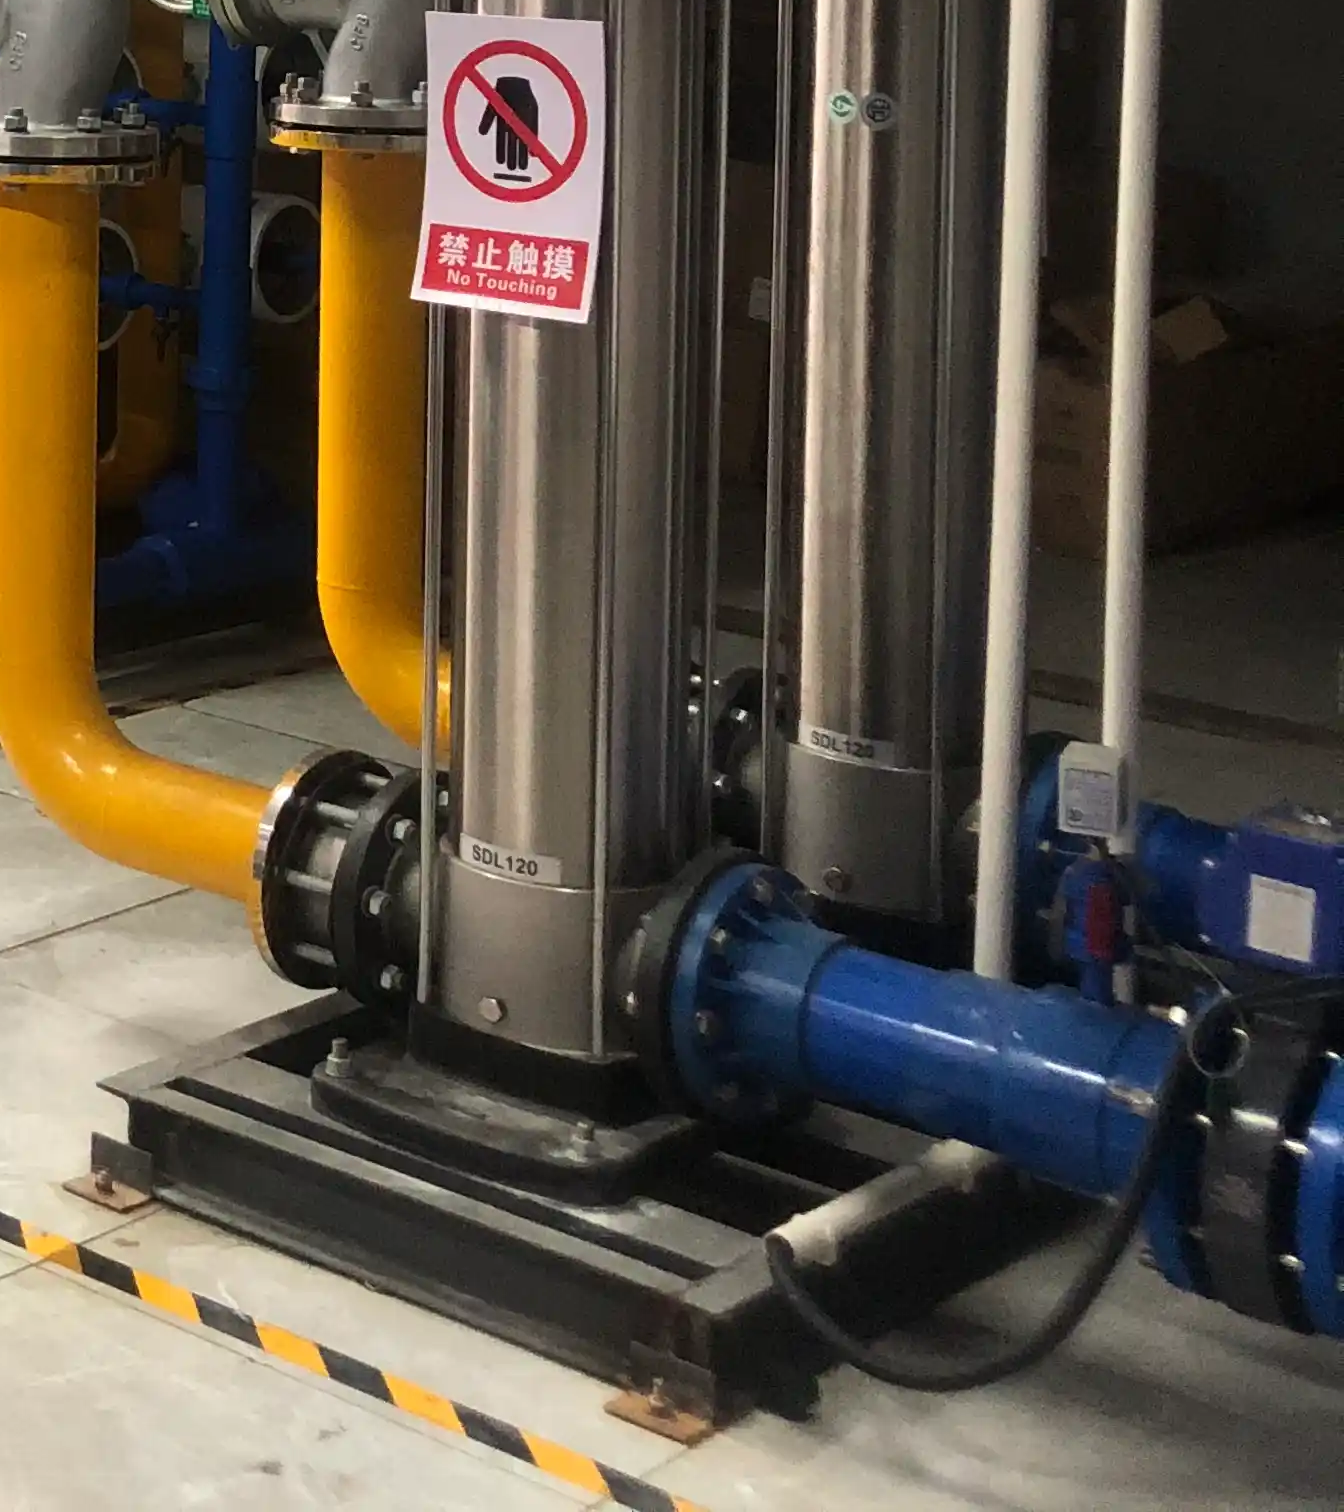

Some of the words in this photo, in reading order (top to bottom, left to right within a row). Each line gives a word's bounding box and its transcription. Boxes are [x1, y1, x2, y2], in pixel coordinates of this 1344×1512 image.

[436, 231, 576, 282] 禁止触摸
[446, 268, 471, 286] No
[475, 271, 558, 301] Touching
[471, 843, 539, 877] SDL120
